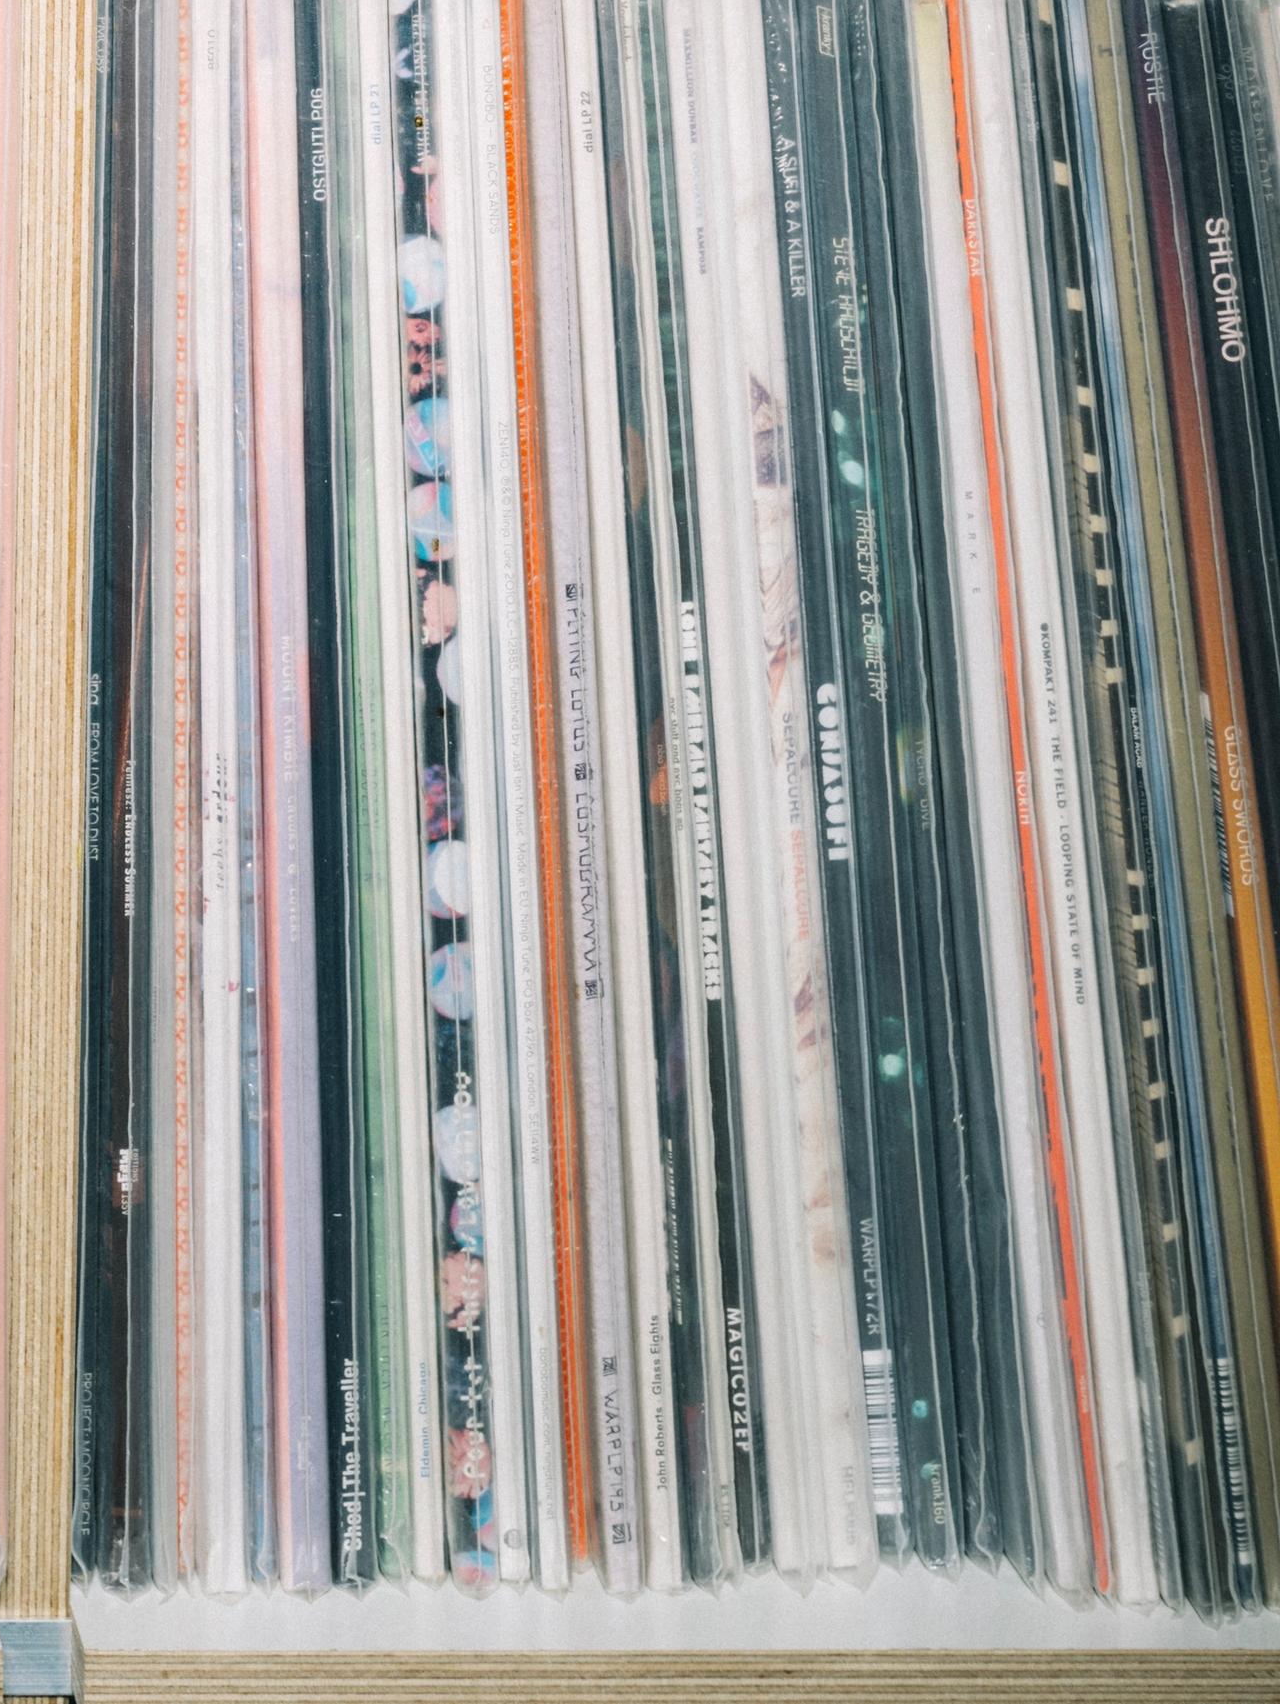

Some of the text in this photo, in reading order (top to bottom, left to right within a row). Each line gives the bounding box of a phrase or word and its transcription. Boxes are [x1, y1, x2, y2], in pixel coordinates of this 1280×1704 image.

[483, 65, 501, 234] BONOBO BLACK SANDS
[788, 238, 807, 298] KILLER
[1205, 217, 1246, 362] SHLOHMO
[1140, 32, 1257, 887] RUSTIE GLASS SWORDS
[782, 711, 810, 941] SEPALCURE SEPALCURE
[817, 683, 849, 861] GONJASUFI
[1040, 632, 1085, 1006] KOMPAKT 241 THE FIELD LOOPING STATE MIND
[342, 1359, 359, 1446] Traveller
[652, 1358, 668, 1490] John Roberts Glass
[929, 1463, 946, 1524] krank160
